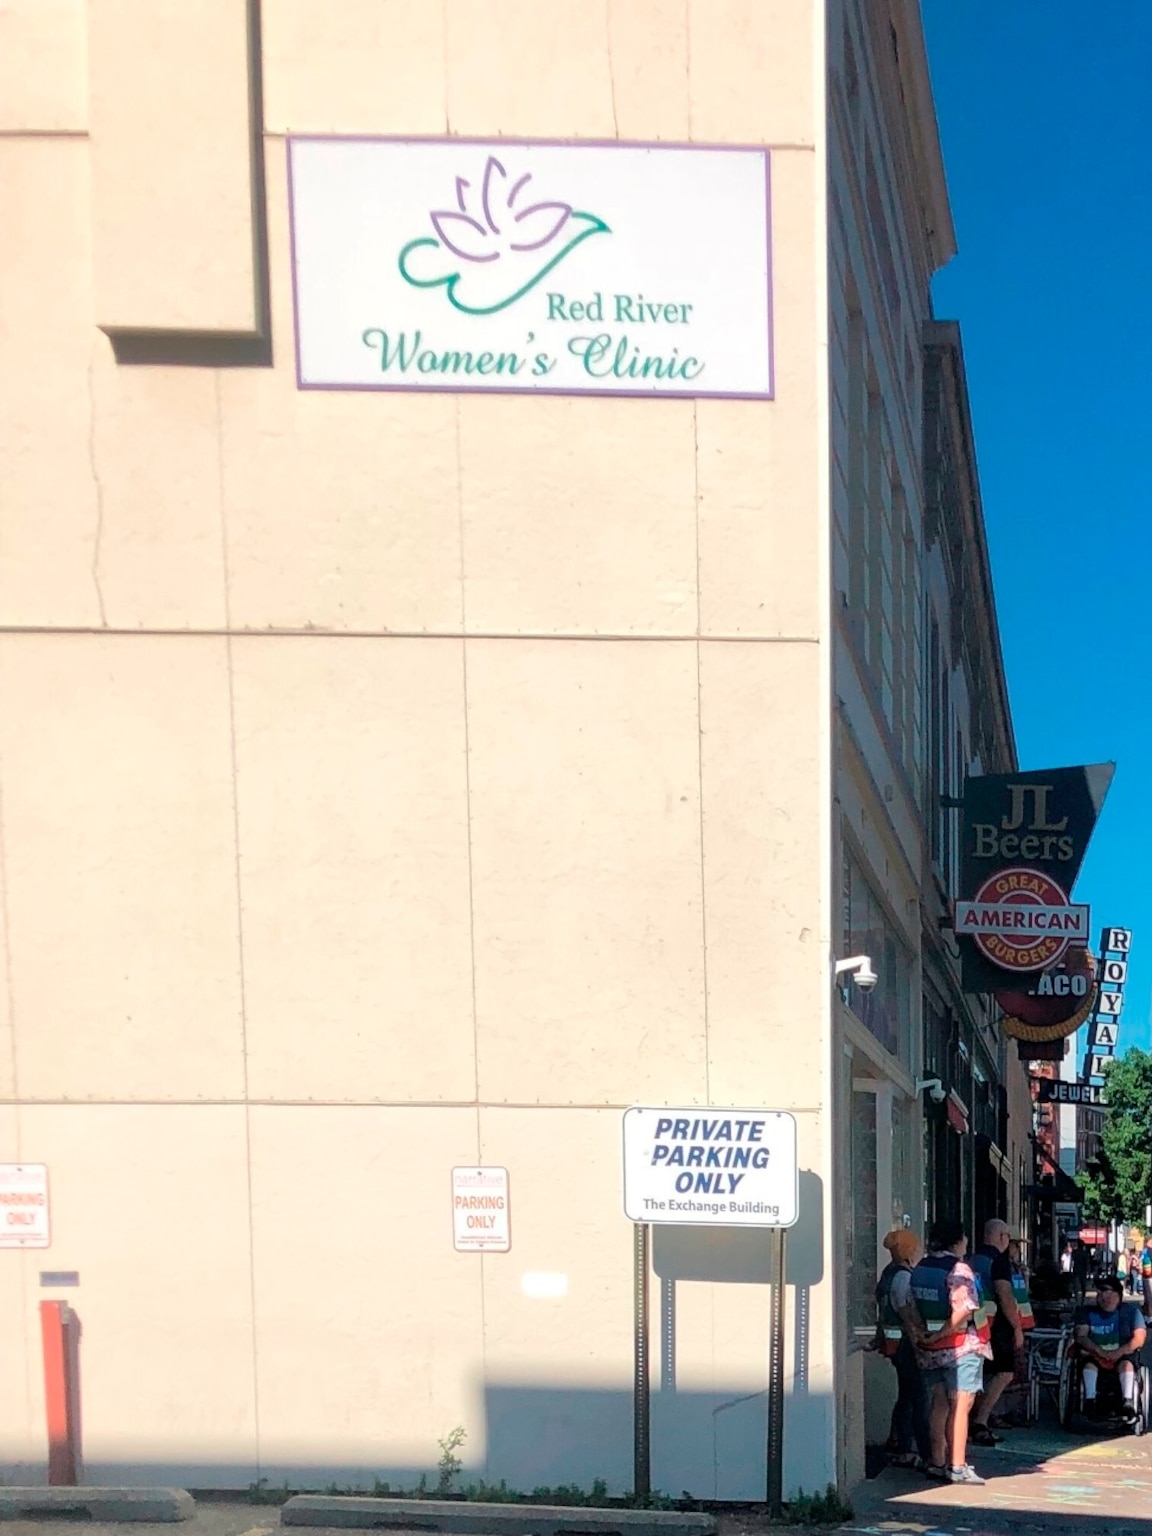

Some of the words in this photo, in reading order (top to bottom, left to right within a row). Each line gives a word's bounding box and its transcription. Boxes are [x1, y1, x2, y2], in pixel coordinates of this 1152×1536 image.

[546, 293, 603, 323] Red
[614, 294, 693, 325] River
[362, 328, 557, 376] Women's
[568, 333, 706, 382] Clinic
[1001, 784, 1068, 831] JL
[972, 823, 1074, 861] Beers
[996, 874, 1049, 896] GREAT
[963, 909, 1081, 931] AMERICAN
[985, 935, 1059, 965] BURGERS
[1028, 974, 1087, 997] ACO
[1095, 931, 1129, 1075] ROYAL
[654, 1118, 765, 1142] PRIVATE
[651, 1144, 770, 1169] PARKING
[675, 1171, 745, 1194] ONLY
[455, 1196, 505, 1210] PARKING
[643, 1198, 666, 1210] The
[668, 1199, 727, 1215] Exchange
[729, 1201, 780, 1217] Building
[466, 1215, 496, 1229] ONLY
